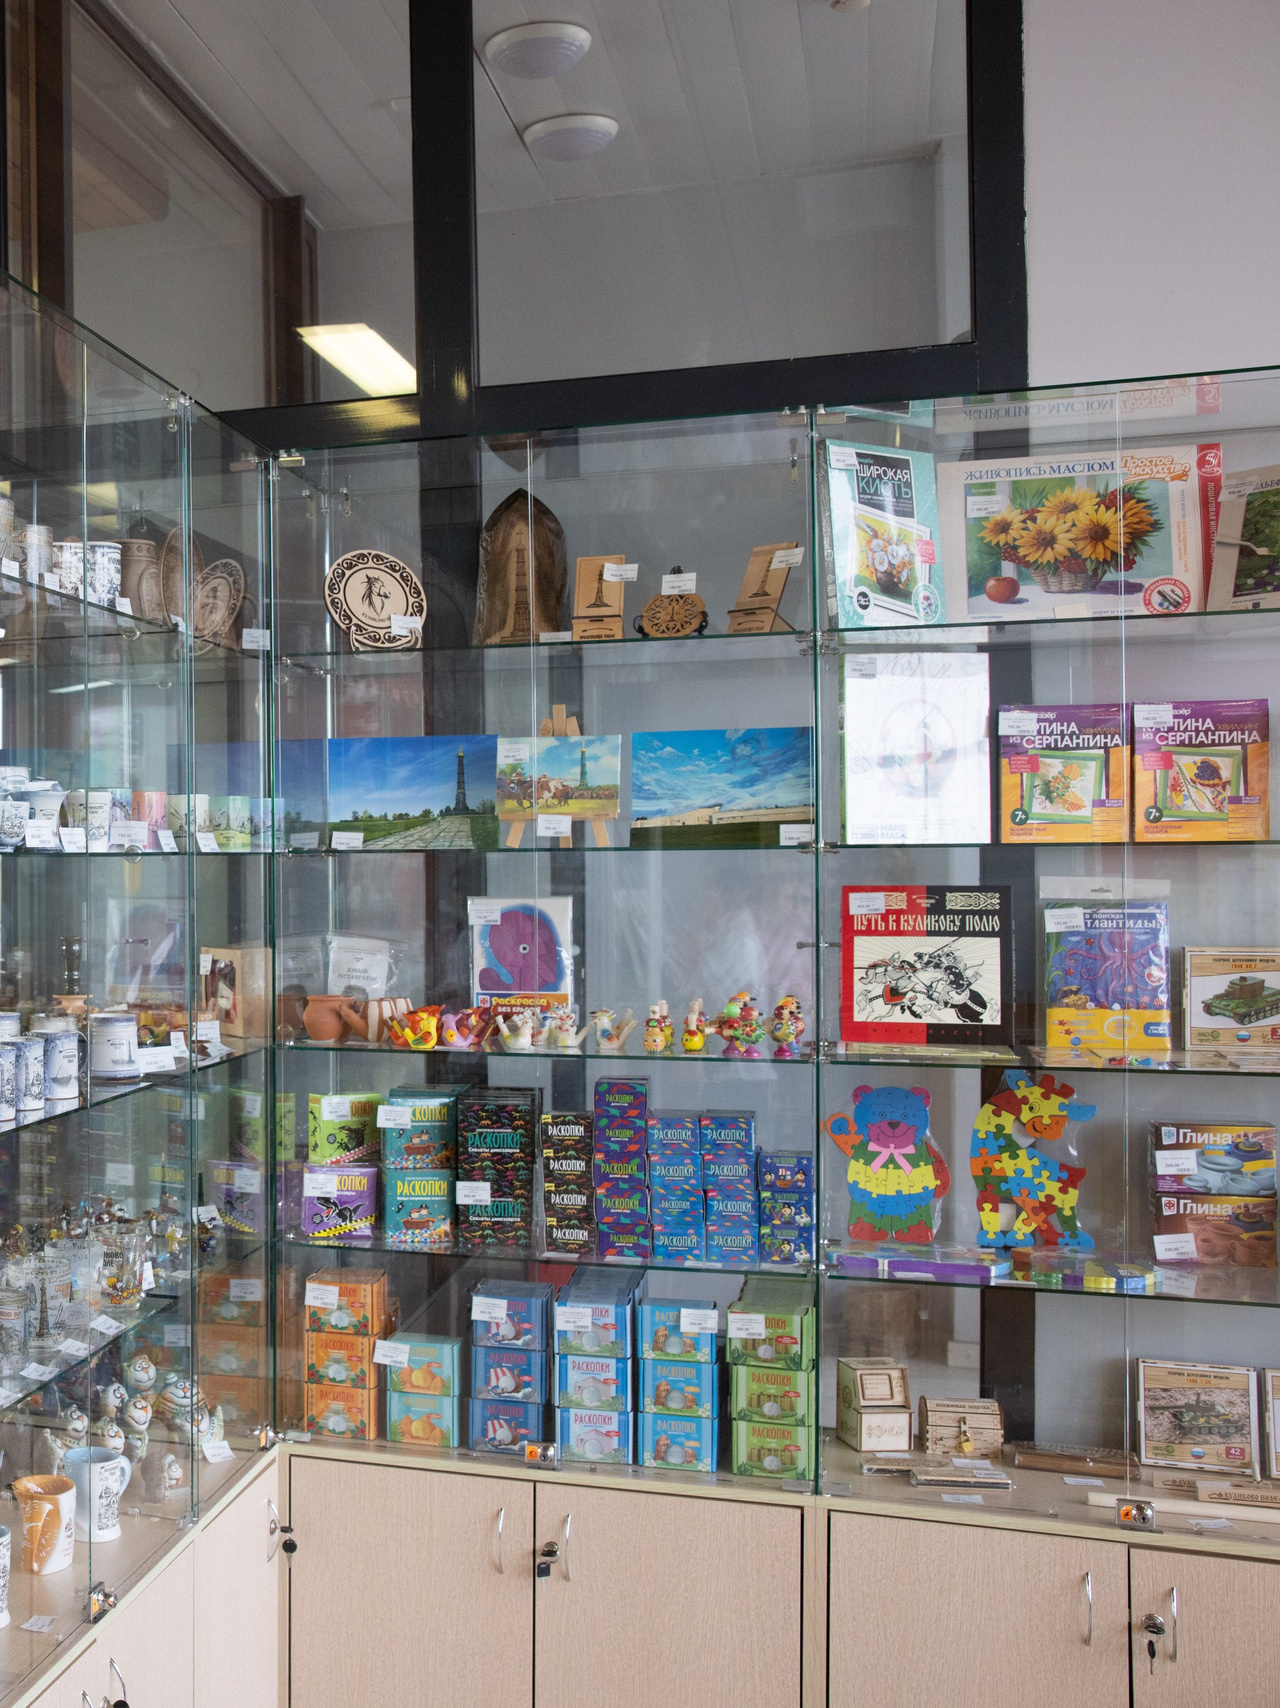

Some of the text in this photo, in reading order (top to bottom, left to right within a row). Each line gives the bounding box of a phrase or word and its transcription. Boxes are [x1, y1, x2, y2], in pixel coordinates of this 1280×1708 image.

[1122, 455, 1173, 471] Простое
[1130, 462, 1191, 477] искусство
[858, 464, 911, 483] ШИРОКАЯ
[964, 460, 1116, 481] ЖИВОПИСЬ МАСЛОМ
[859, 477, 912, 498] КИСТЬ
[1207, 482, 1217, 520] ПОШАГОВАЯ
[1037, 721, 1080, 735] ТИНА
[1009, 734, 1123, 749] ИЗ СЕРПАНТИНА
[1155, 730, 1262, 745] СЕРПАНТИНА
[1015, 811, 1026, 823] 7+
[1148, 808, 1160, 820] 7+
[853, 913, 1001, 932] ПУТЬ К КУЛИКОВУ ПОЛЮ
[345, 967, 369, 975] ЮНЫЙ
[491, 995, 548, 1007] Раскраска
[605, 1094, 634, 1104] РАСКОПКИ
[350, 1101, 375, 1117] ОПКИ
[547, 1124, 585, 1137] РАСКОПКИ
[605, 1128, 634, 1138] РАСКОПКИ
[654, 1128, 692, 1141] РАСКОПКИ
[707, 1128, 746, 1141] РАСКОПКИ
[1178, 1128, 1233, 1144] Глина
[467, 1131, 521, 1149] РАСКОПКИ
[549, 1159, 586, 1172] РАСКОПКИ
[601, 1163, 637, 1175] РАСКОПКИ
[656, 1165, 694, 1177] РАСКОПКИ
[710, 1164, 749, 1177] РАСКОПКИ
[336, 1175, 368, 1191] КОПКИ
[396, 1180, 448, 1196] РАСКОПКИ
[550, 1193, 587, 1206] РАСКОПКИ
[602, 1197, 639, 1210] РАСКОПКИ
[661, 1200, 691, 1210] РАСКОПКИ
[714, 1200, 752, 1212] РАСКОПКИ
[468, 1201, 522, 1217] РАСКОПКИ
[1179, 1199, 1233, 1215] Глина
[552, 1227, 589, 1242] РАСКОПКИ
[659, 1235, 697, 1248] РАСКОПКИ
[714, 1235, 752, 1248] РАСКОПКИ
[506, 1300, 528, 1313] ОПКИ
[591, 1306, 610, 1319] ОПКИ
[655, 1310, 681, 1323] РАСКО
[764, 1317, 787, 1330] ОПКИ
[489, 1351, 528, 1366] РАСКОПКИ
[571, 1360, 611, 1374] РАСКОПКИ
[656, 1365, 697, 1379] РАСКОПКИ
[751, 1372, 792, 1388] РАСКОПКИ
[486, 1403, 525, 1419] РАСКОПКИ
[574, 1412, 613, 1426] РАСКОПКИ
[656, 1419, 697, 1434] РАСКОПКИ
[751, 1426, 792, 1441] РАСКОПКИ
[1229, 1447, 1241, 1456] 42
[1223, 1490, 1279, 1503] КУЛИКОВО ПОЛЕ
